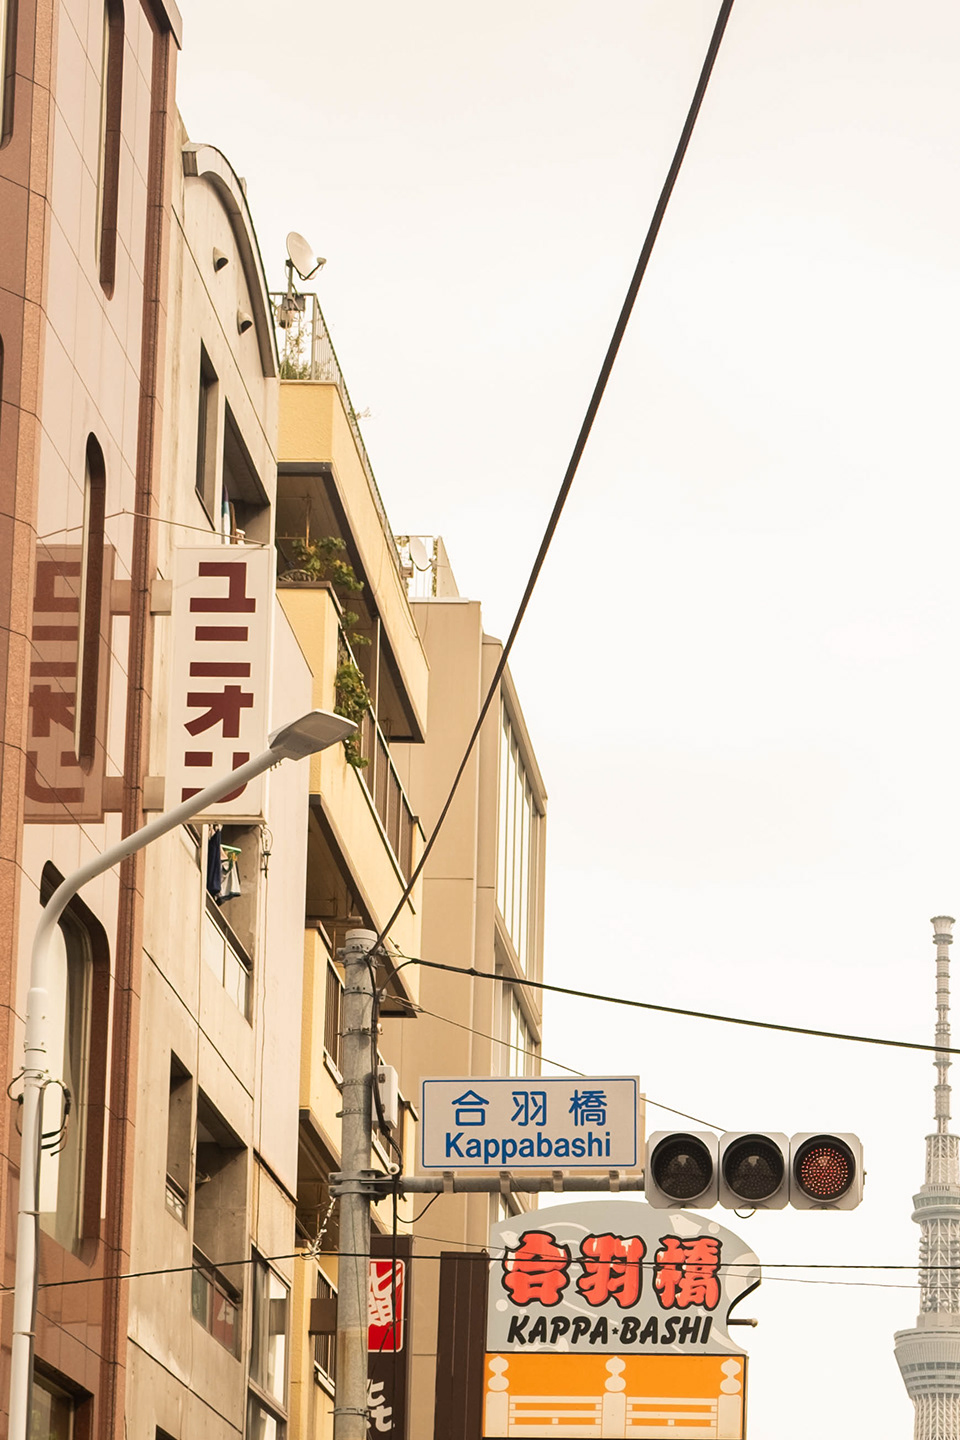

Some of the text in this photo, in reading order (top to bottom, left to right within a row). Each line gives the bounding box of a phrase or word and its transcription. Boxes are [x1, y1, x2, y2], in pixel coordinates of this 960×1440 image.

[181, 562, 256, 803] ユニオン
[451, 1090, 607, 1127] 合羽橋
[445, 1132, 611, 1163] Kappabashi
[501, 1230, 723, 1310] 合羽橋
